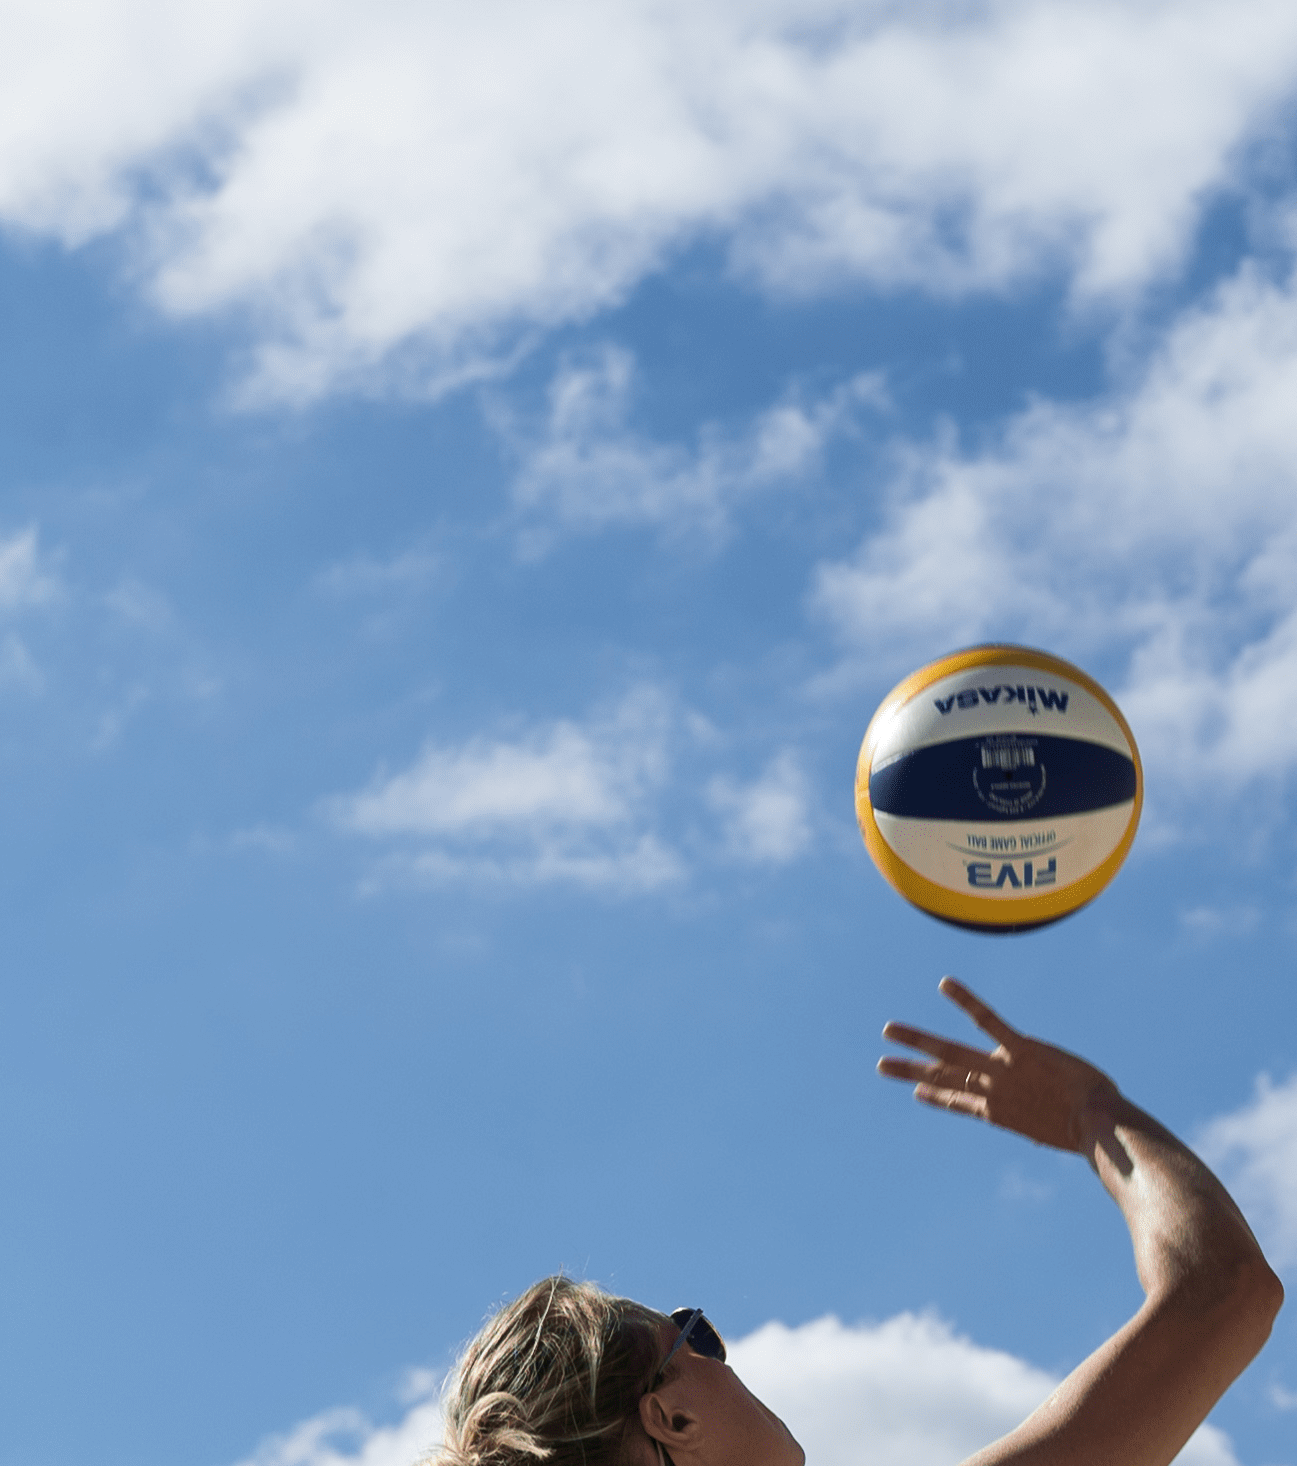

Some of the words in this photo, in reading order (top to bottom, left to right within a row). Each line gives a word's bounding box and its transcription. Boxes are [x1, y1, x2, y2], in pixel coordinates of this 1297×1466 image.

[967, 833, 988, 850] BALL
[990, 833, 1018, 851] GAME
[1020, 829, 1057, 850] OFFICIAL
[966, 857, 1057, 890] FIVB
